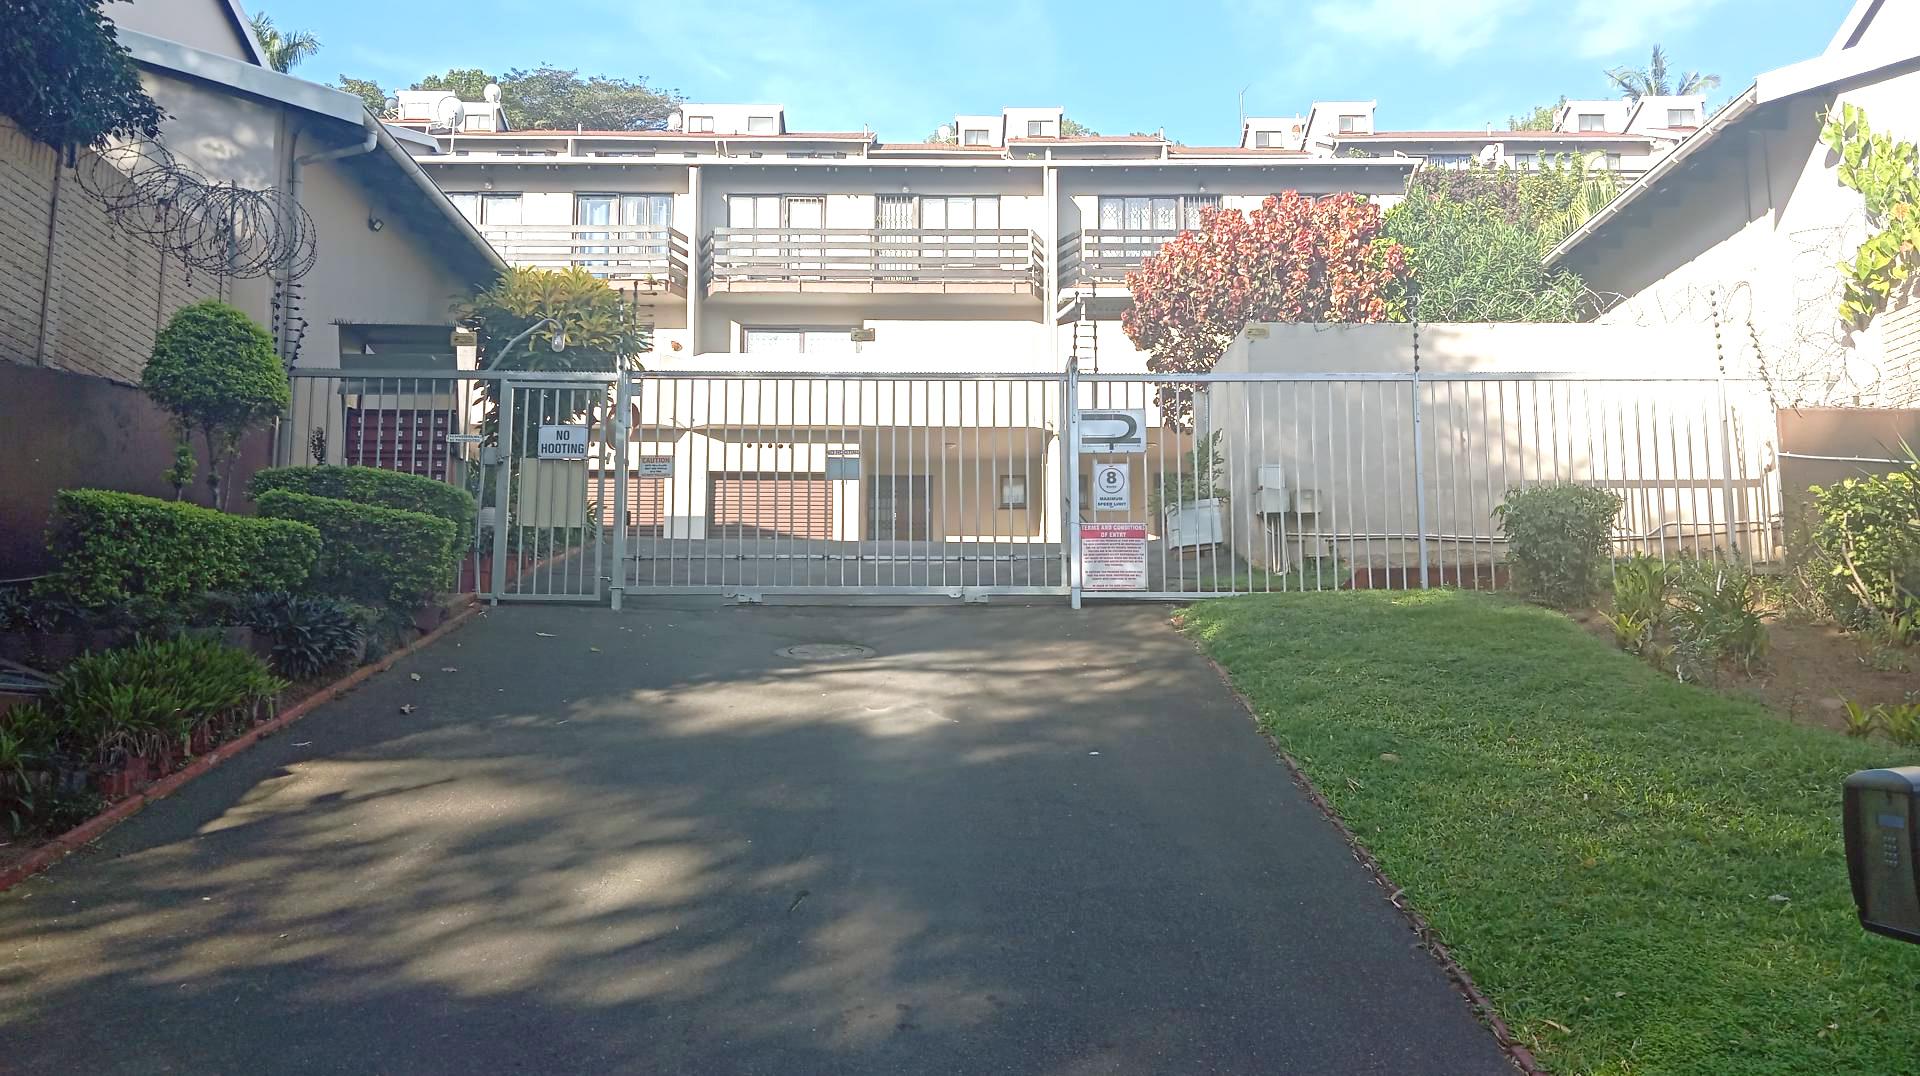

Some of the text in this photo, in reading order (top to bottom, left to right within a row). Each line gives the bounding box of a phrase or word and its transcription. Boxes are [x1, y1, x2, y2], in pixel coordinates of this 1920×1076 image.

[556, 430, 570, 440] NO
[541, 443, 584, 453] HOOTING
[1106, 471, 1116, 484] 8
